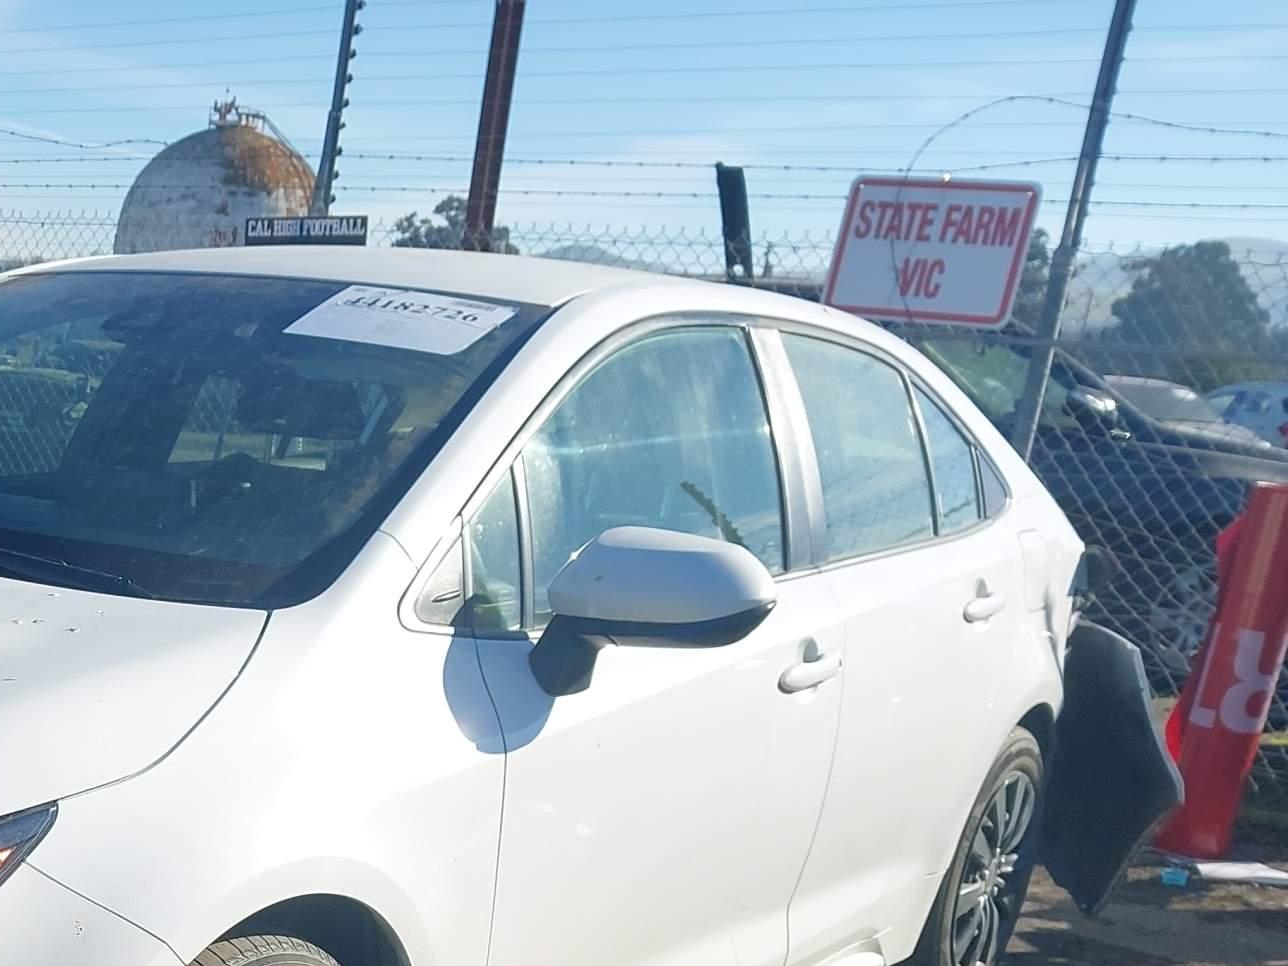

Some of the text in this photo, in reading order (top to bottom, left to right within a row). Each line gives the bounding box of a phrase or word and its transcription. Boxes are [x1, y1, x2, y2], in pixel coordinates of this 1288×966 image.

[247, 218, 365, 237] CAL HIGH FOOTBALL
[855, 201, 1022, 247] STATE FARM
[899, 258, 945, 299] VIC
[343, 295, 479, 323] 44182726
